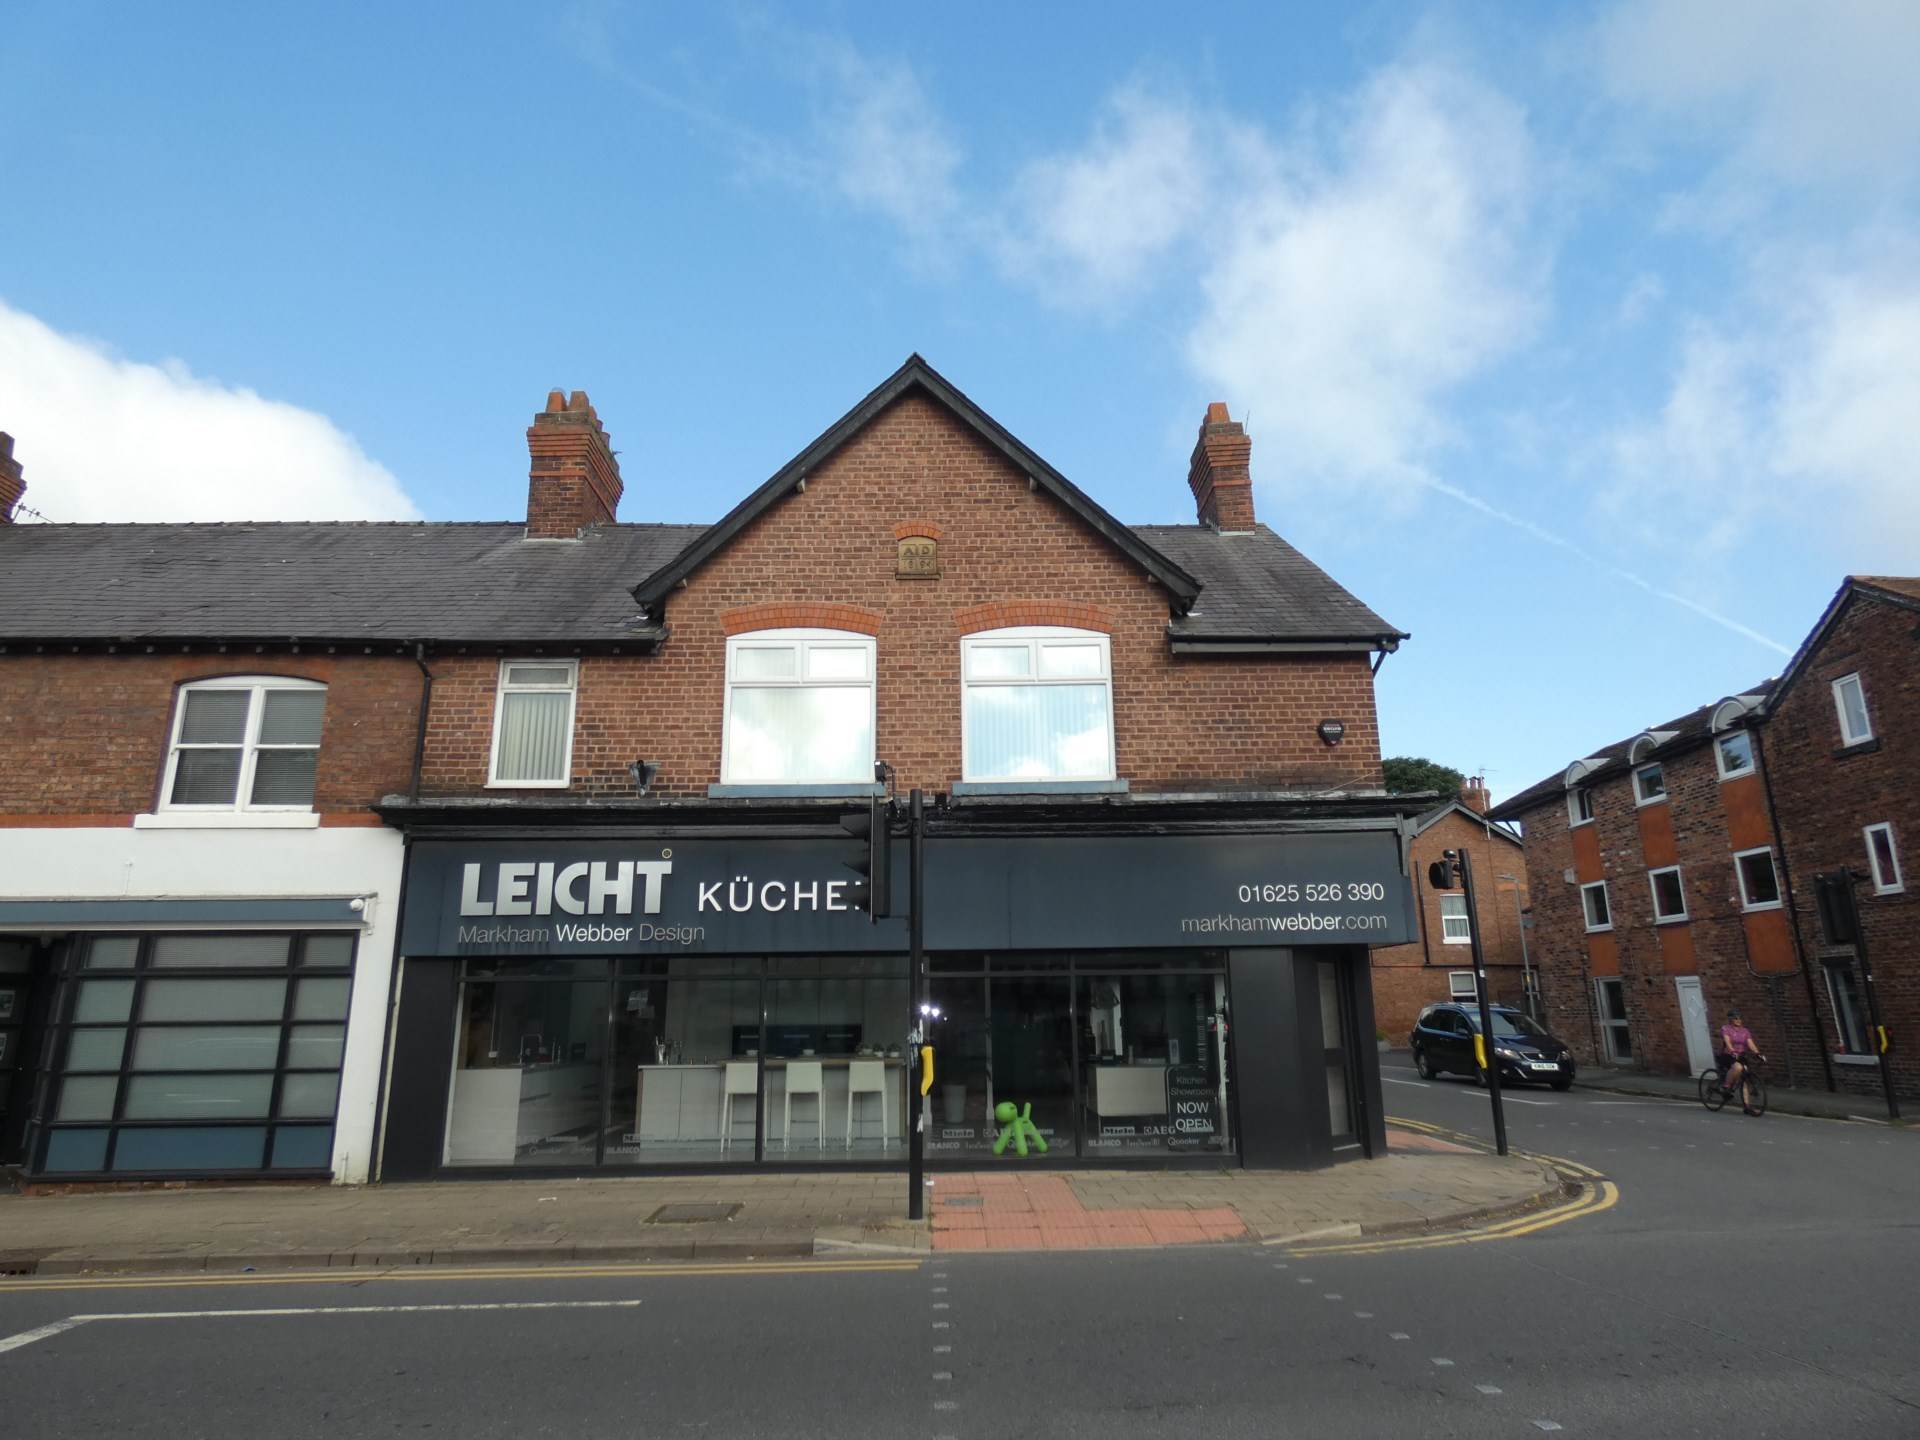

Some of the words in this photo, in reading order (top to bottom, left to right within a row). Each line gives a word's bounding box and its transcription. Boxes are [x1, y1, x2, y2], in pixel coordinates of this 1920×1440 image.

[459, 861, 672, 916] LEICHT
[698, 875, 862, 913] KÜCHE
[1238, 884, 1300, 903] 01625
[1305, 883, 1343, 902] 526
[1347, 882, 1385, 901] 390
[457, 924, 549, 944] Markham
[554, 922, 634, 942] Webber
[639, 923, 705, 945] Design
[1181, 912, 1388, 934] markhamwebber.com
[1177, 1102, 1209, 1114] NOW
[1153, 1126, 1176, 1135] AEG
[1175, 1118, 1213, 1133] OPEN
